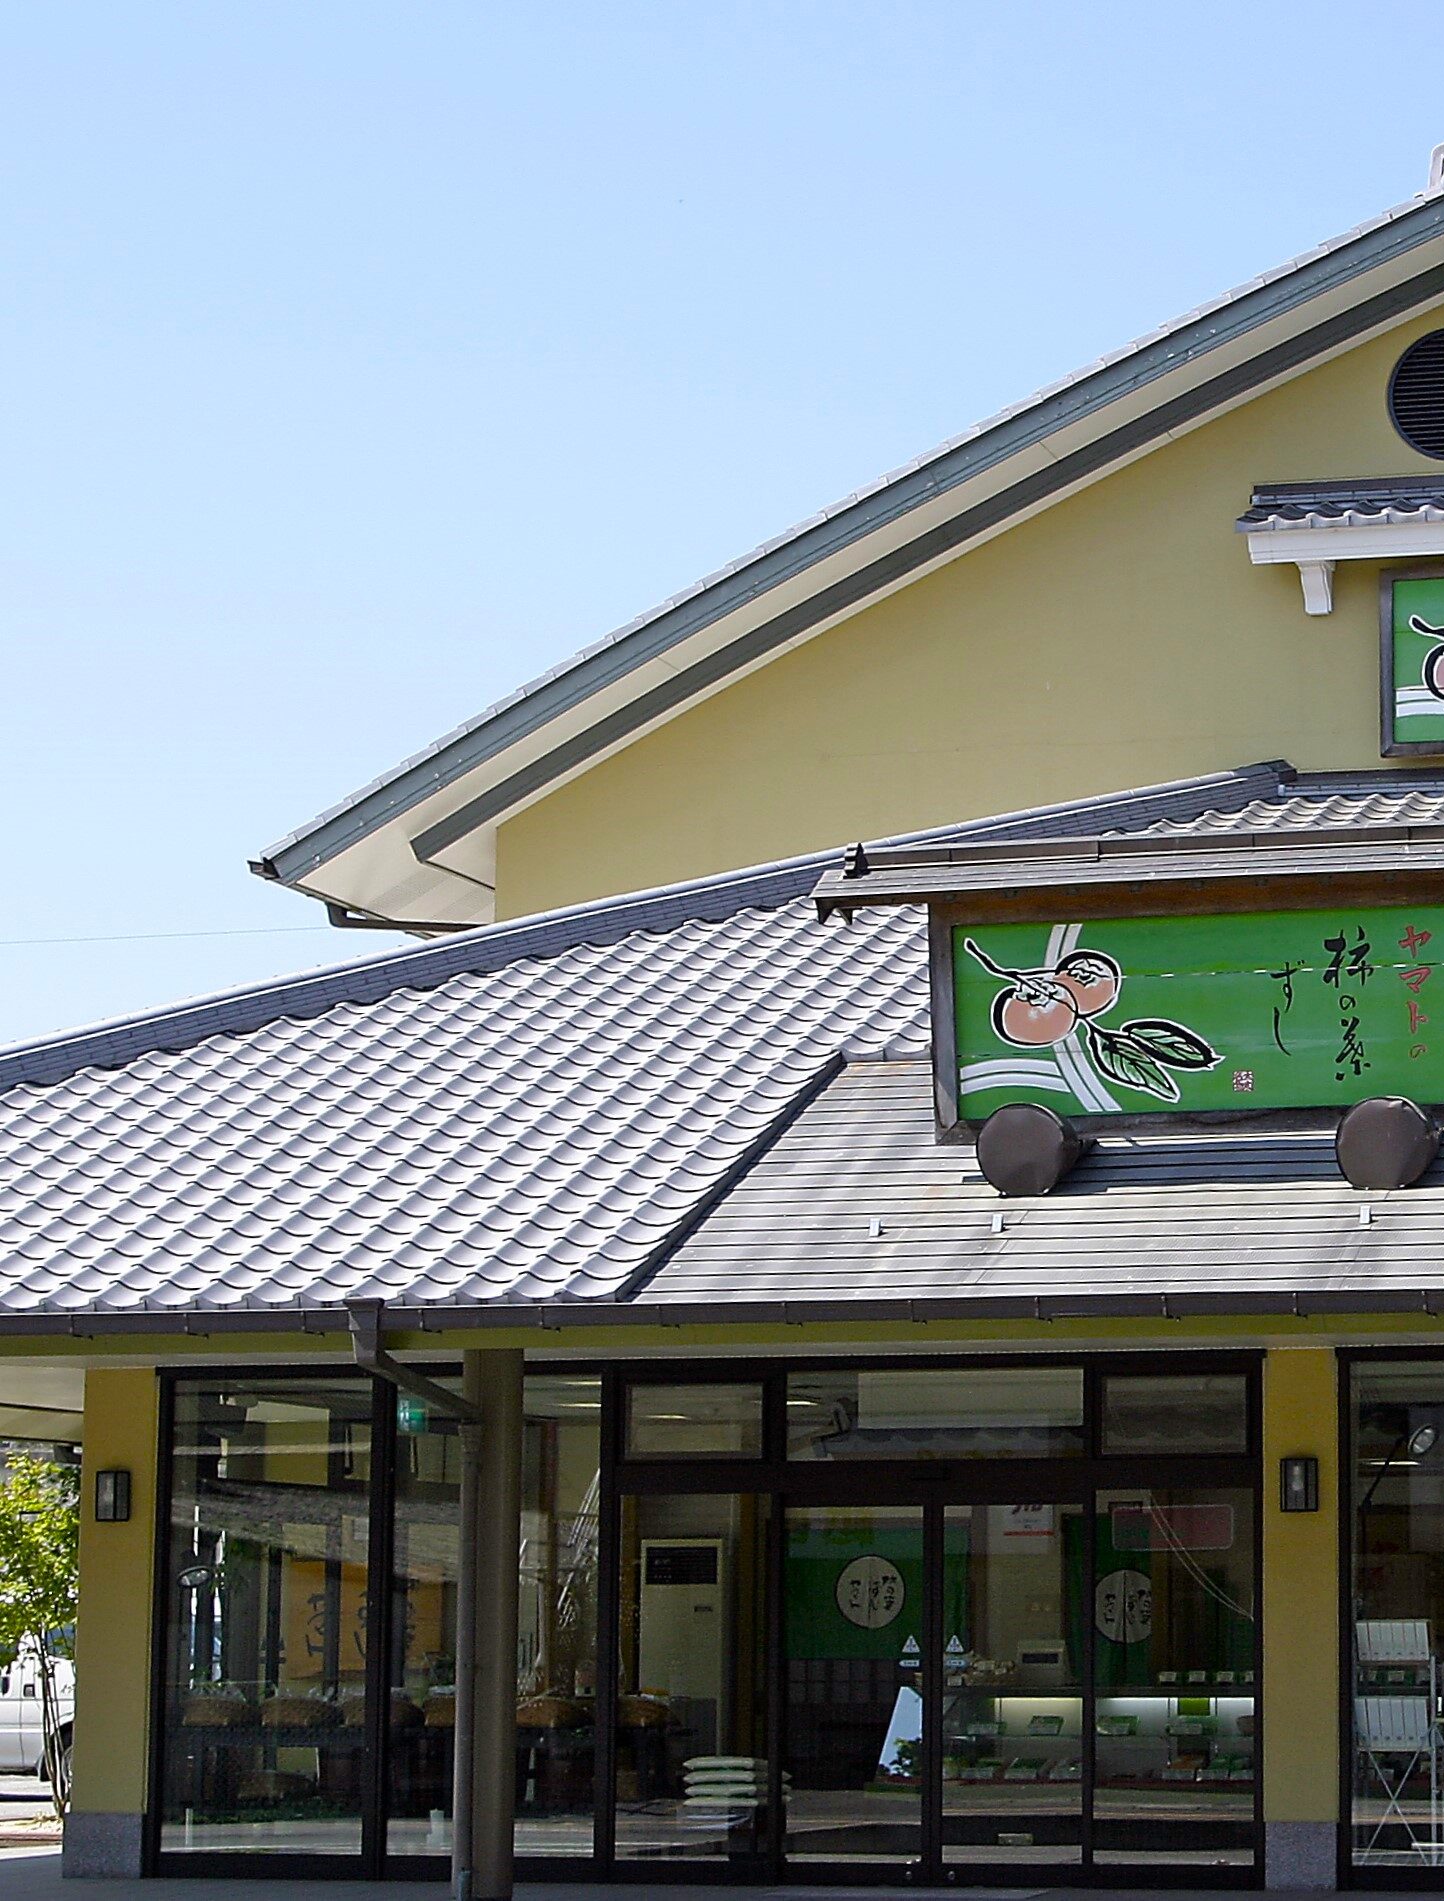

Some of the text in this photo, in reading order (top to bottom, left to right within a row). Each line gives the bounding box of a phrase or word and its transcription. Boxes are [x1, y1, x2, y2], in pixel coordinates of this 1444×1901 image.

[1270, 959, 1306, 1057] ずし
[1323, 925, 1374, 1081] 柿の葉
[1398, 925, 1432, 1059] ヤマトの
